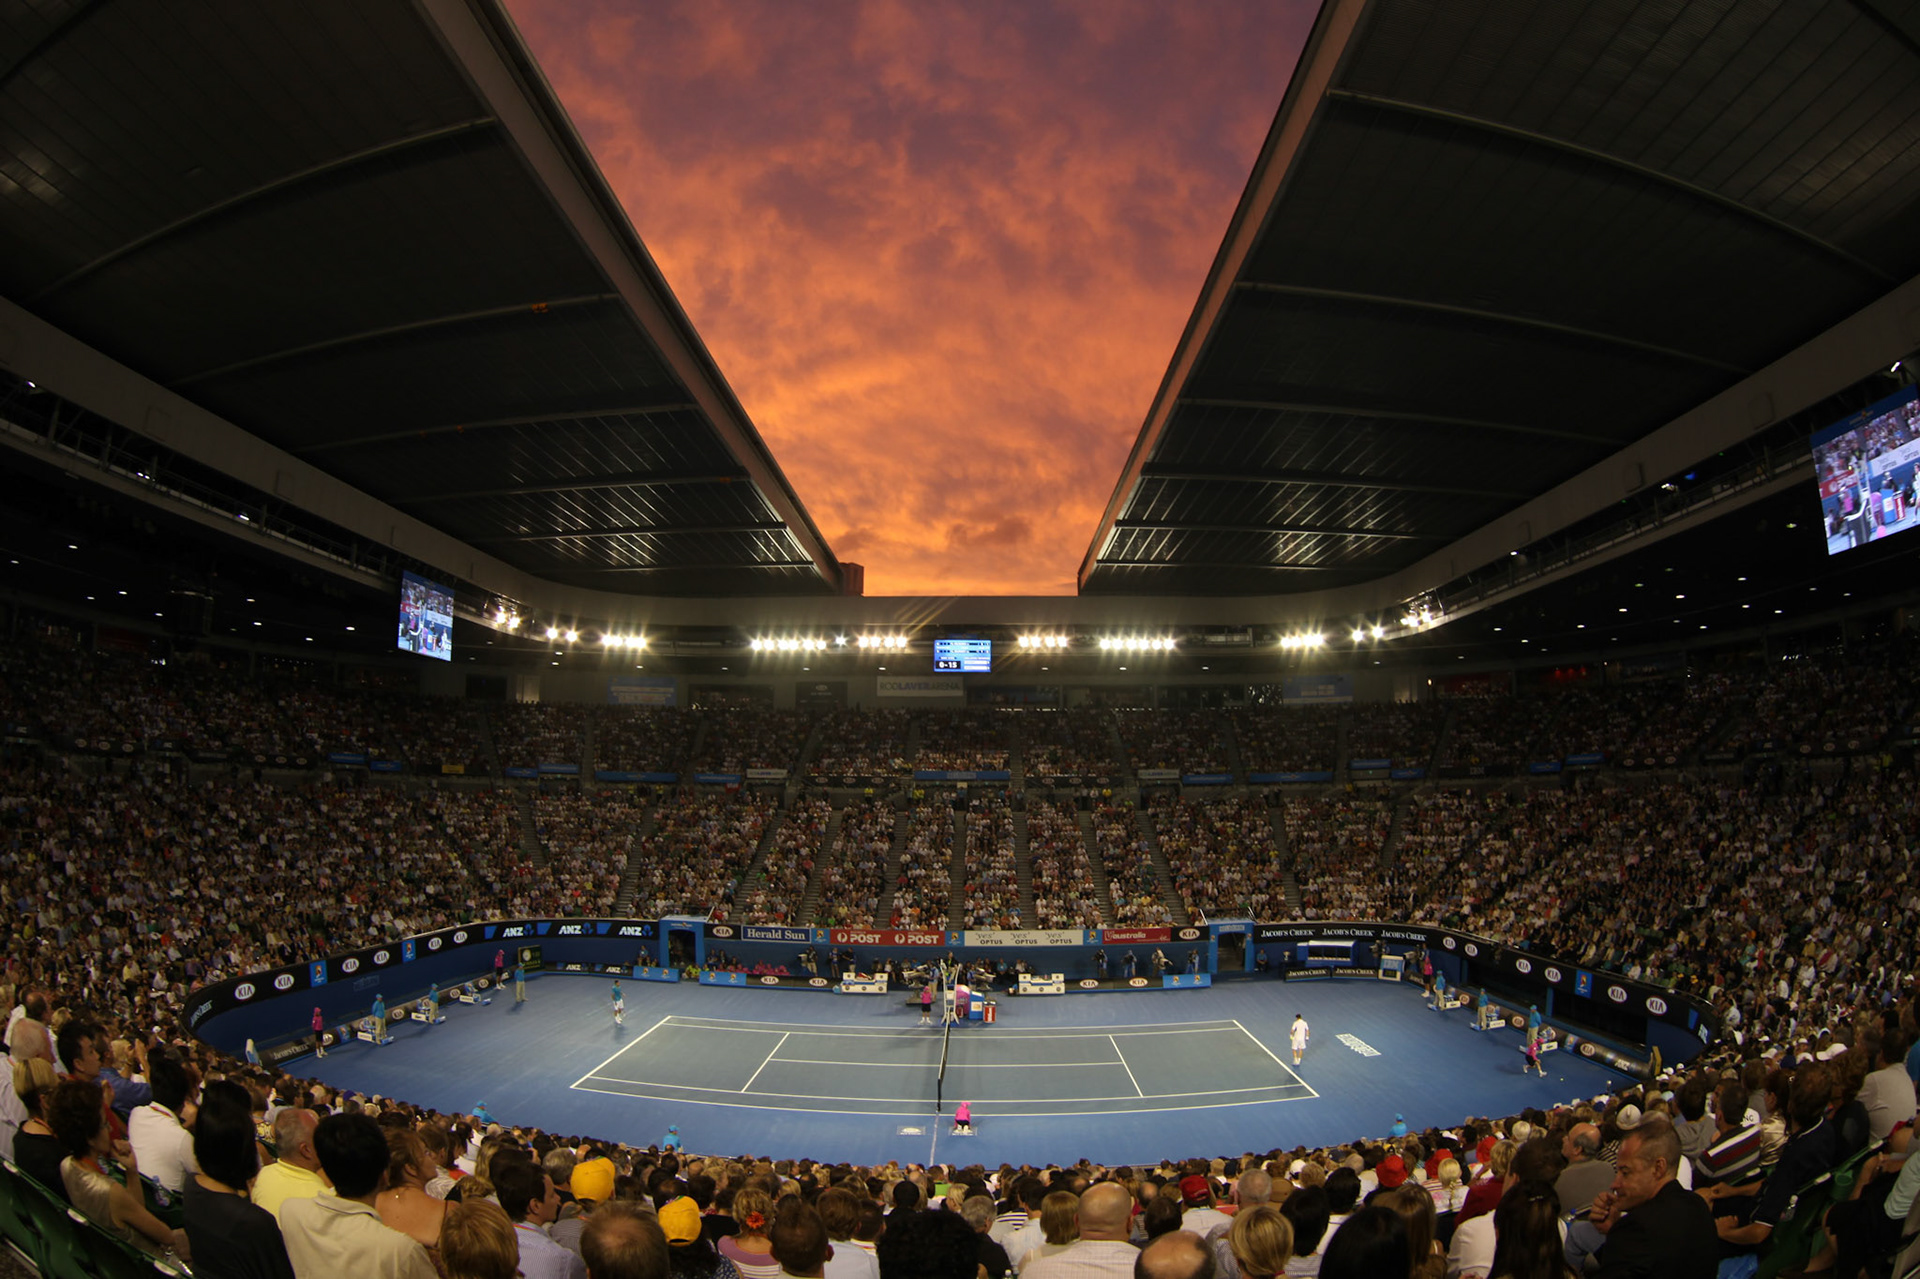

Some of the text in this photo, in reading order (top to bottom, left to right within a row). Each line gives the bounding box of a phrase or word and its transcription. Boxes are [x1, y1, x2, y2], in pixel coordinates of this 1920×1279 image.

[502, 926, 524, 938] ANZ
[558, 924, 582, 935] ANZ
[618, 926, 643, 937] ANZ
[715, 928, 731, 936] KIA
[746, 928, 806, 940] Herald Sun
[1181, 930, 1199, 938] KIA
[1260, 928, 1315, 938] JACOB'S CREEK
[1322, 927, 1375, 937] JACOB'S CREEK
[849, 934, 882, 944] POST
[907, 935, 940, 945] POST
[1380, 929, 1427, 942] JACOB'S CREEK
[375, 952, 389, 963] KIA
[343, 960, 359, 971] KIA
[565, 963, 582, 971] ANZ
[606, 965, 622, 973] ANZ
[1517, 961, 1530, 971] KIA
[1545, 969, 1560, 980] KIA
[276, 975, 293, 988] KIA
[237, 985, 253, 998] KIA
[1610, 987, 1625, 1000] KIA
[1648, 1000, 1665, 1012] KIA
